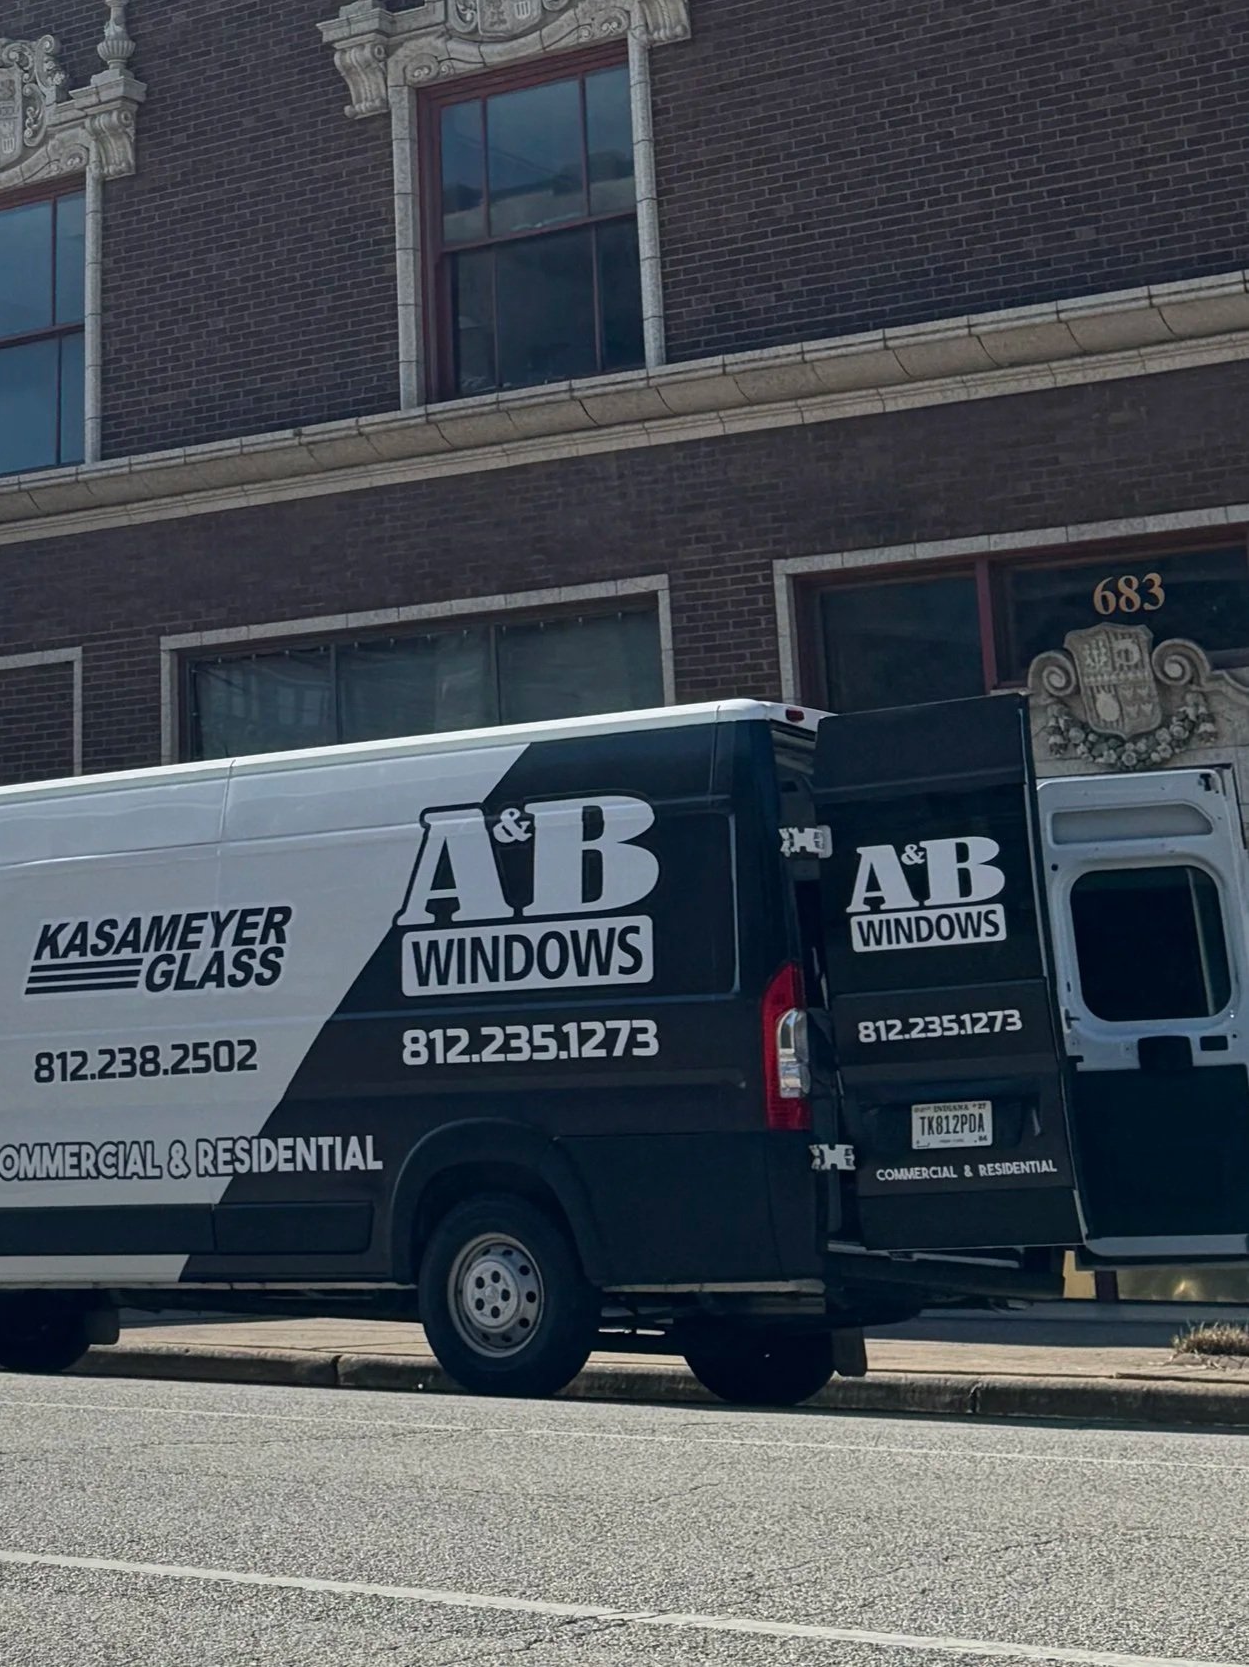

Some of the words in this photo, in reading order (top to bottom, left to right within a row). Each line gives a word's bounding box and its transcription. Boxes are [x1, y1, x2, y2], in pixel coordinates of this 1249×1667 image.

[1093, 572, 1165, 615] 683
[397, 795, 660, 926] A&B
[845, 836, 1006, 913] A&B
[33, 905, 293, 961] KASAMEYER
[856, 909, 1001, 948] WINDOWS
[145, 946, 285, 993] GLASS
[411, 925, 643, 987] WINDOWS
[402, 1019, 660, 1066] 812.235.1273
[857, 1008, 1023, 1043] 812.235.1273
[34, 1039, 258, 1083] 812.238.2502
[919, 1112, 985, 1137] TK812PDA
[933, 1103, 970, 1113] INDIANA
[167, 1139, 191, 1180] &
[196, 1135, 383, 1177] RESIDENTIAL
[876, 1165, 958, 1182] COMMERCIAL
[963, 1164, 974, 1178] &
[978, 1159, 1058, 1178] RESIDENTIAL
